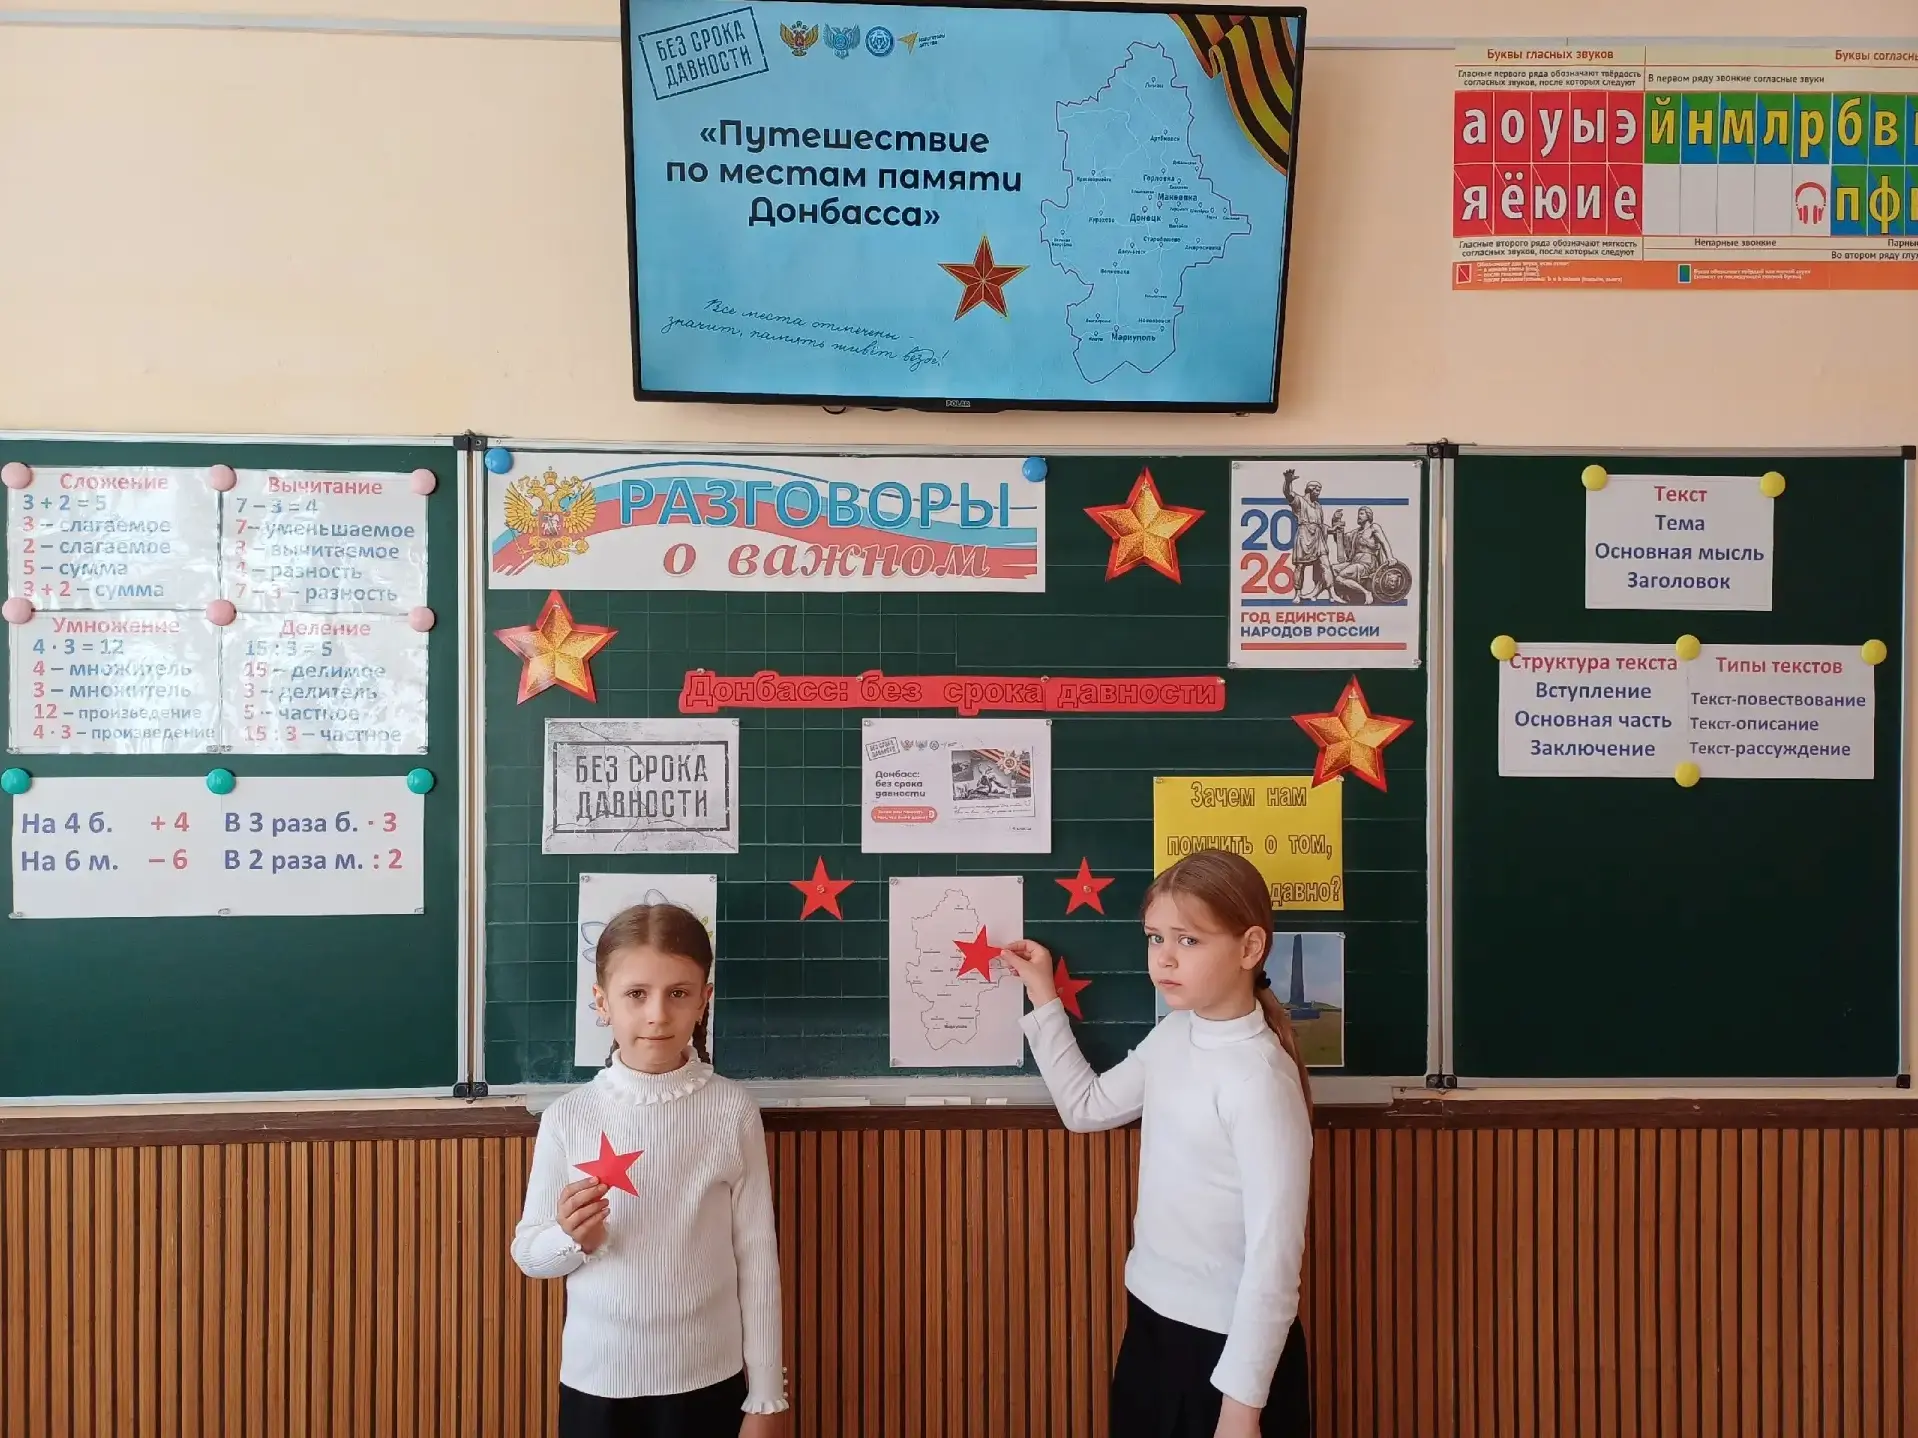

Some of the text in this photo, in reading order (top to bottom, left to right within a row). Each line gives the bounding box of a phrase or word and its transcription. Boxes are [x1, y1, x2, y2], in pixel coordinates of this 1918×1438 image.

[656, 20, 745, 63] БЕЗ СРОКА
[1487, 49, 1613, 60] Буквы гласных звуков
[1835, 50, 1870, 61] Буквы
[665, 45, 752, 89] ДАВНОСТИ
[1458, 70, 1492, 78] Гласные
[1551, 70, 1598, 78] обозначают
[1601, 70, 1641, 78] твёрдость
[1508, 79, 1537, 87] звуков,
[1603, 79, 1635, 87] следуют
[1649, 74, 1654, 82] В
[1657, 75, 1690, 83] первом
[1692, 75, 1713, 83] ряду
[1754, 75, 1797, 83] согласные
[1800, 75, 1824, 83] звуки
[700, 120, 990, 153] «Путешествие
[666, 162, 1022, 193] по местам памяти
[1158, 193, 1197, 201] Макеевка
[748, 197, 940, 228] Донбасса»
[1130, 213, 1161, 222] Донецк
[1460, 240, 1637, 249] Гласные второго ряда обозначают мягкость
[1694, 239, 1776, 248] Непарные звонкие
[1462, 249, 1505, 257] согласных
[1508, 249, 1537, 257] звуков,
[1601, 249, 1634, 257] следуют
[1845, 252, 1876, 260] втором
[1879, 252, 1900, 260] ряду
[703, 298, 899, 340] Все места отмечены
[750, 329, 824, 349] память
[1112, 333, 1156, 342] Мариуполь
[60, 473, 169, 490] Сложение
[269, 477, 383, 495] Вычитание
[1654, 486, 1707, 503] Текст
[620, 479, 1009, 528] РАЗГОВОРЫ
[60, 520, 171, 533] слагаемое
[265, 524, 415, 538] уменьшаемое
[1240, 509, 1298, 551] 20
[1655, 515, 1705, 531] Тема
[59, 541, 171, 554] слагаемое
[1595, 544, 1764, 562] Основная мысль
[663, 541, 992, 578] о важном
[59, 562, 128, 578] сумма
[271, 566, 362, 581] разность
[1240, 553, 1295, 594] 26
[1627, 573, 1731, 590] Заголовок
[95, 583, 164, 598] сумма
[306, 587, 398, 603] разность
[52, 617, 180, 634] Умножение
[1241, 612, 1356, 623] ГОД ЕДИНСТВА
[279, 620, 371, 639] Деление
[1241, 627, 1379, 638] НАРОДОВ РОССИИ
[69, 664, 192, 677] множитель
[1510, 653, 1678, 674] Структура текста
[1716, 658, 1843, 676] Типы текстов
[291, 666, 386, 681] делимое
[69, 685, 192, 698] множитель
[686, 675, 1216, 709] Донбасс: без срока давности
[1535, 682, 1652, 701] Вступление
[1691, 692, 1866, 709] Текст-повествование
[79, 709, 201, 722] произведение
[1515, 712, 1671, 729] Основная часть
[1690, 716, 1819, 733] Текст-описание
[92, 728, 215, 741] произведение
[320, 728, 401, 742] частное
[1530, 740, 1655, 759] Заключение
[1690, 741, 1851, 759] Текст-рассуждение
[576, 755, 708, 783] БЕЗ СРОКА
[875, 770, 920, 778] Донбасс:
[1191, 781, 1306, 808] Зачем нам
[576, 790, 707, 821] ДАВНОСТИ
[22, 811, 113, 834] На 4 б.
[225, 811, 358, 836] В 3 раза б.
[1167, 835, 1332, 859] помнить о том,
[21, 850, 118, 871] На 6 м.
[224, 849, 363, 873] В 2 раза м.
[1271, 876, 1341, 907] давно?
